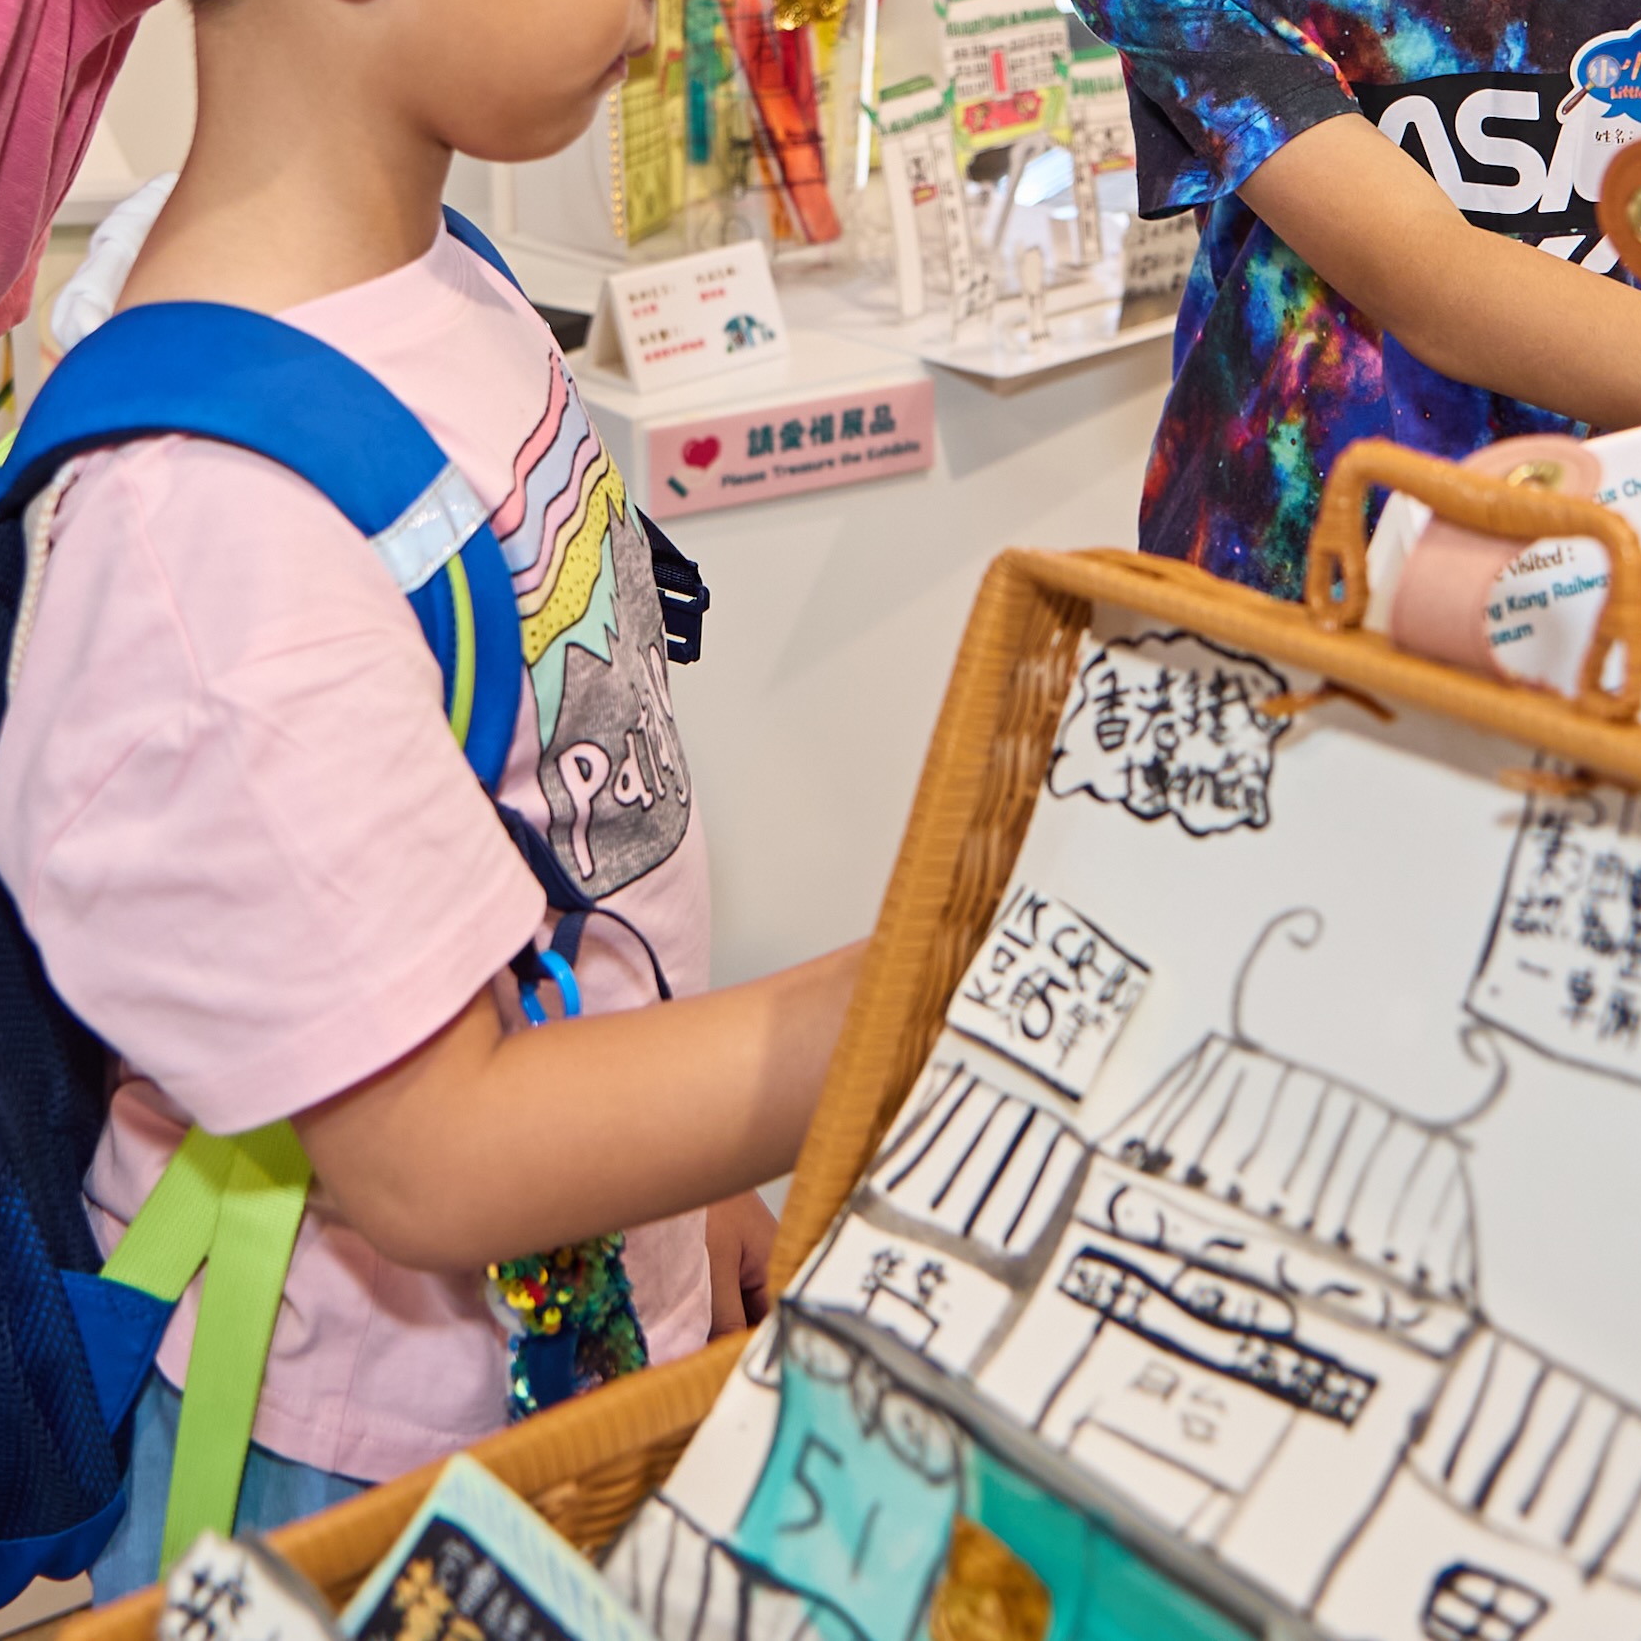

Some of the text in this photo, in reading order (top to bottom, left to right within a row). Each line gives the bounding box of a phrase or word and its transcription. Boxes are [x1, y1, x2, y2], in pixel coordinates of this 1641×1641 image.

[747, 404, 897, 458] 請愛惜展品
[721, 441, 921, 488] Please Treasure the Exhibits
[1507, 588, 1548, 616] Kong
